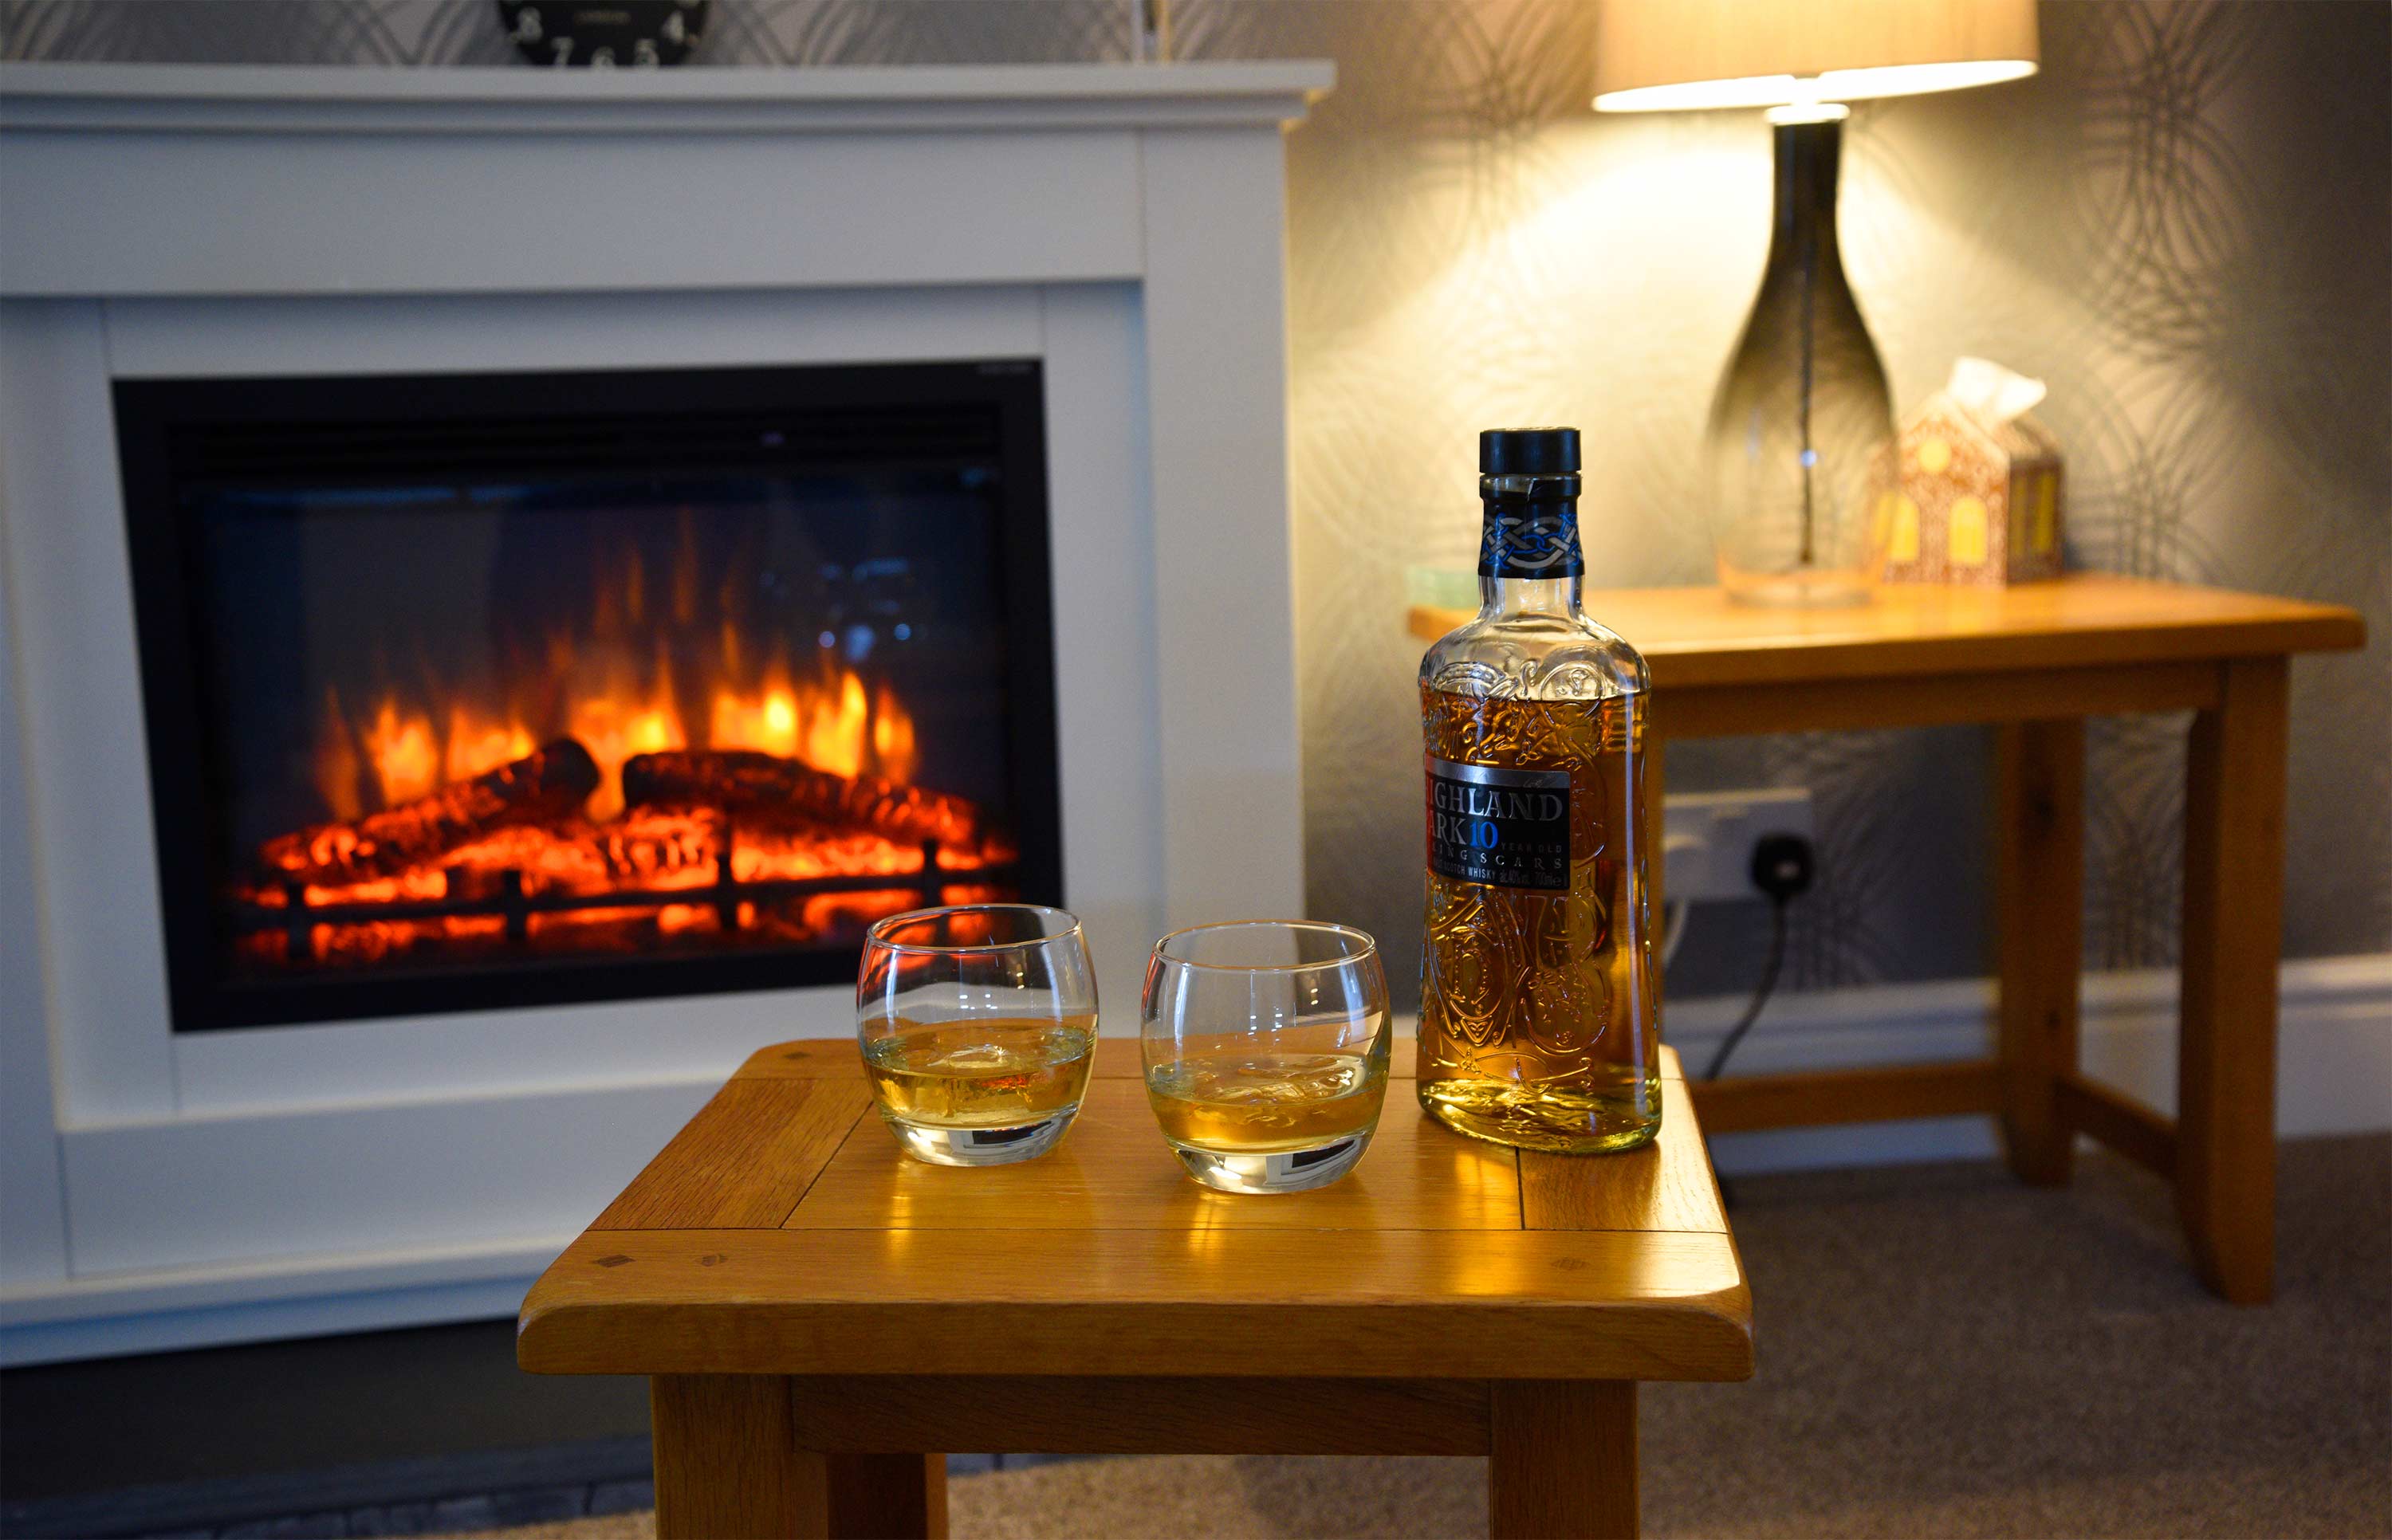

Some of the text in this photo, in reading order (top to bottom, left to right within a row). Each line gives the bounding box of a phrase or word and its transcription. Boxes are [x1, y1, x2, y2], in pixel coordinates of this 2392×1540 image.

[517, 6, 544, 44] 8
[660, 10, 685, 44] 4
[550, 36, 575, 66] 7
[1426, 778, 1563, 822] IGHLAND
[1427, 809, 1499, 849] ARK 10
[1468, 866, 1496, 880] WHISKY
[1480, 852, 1562, 870] SCARS
